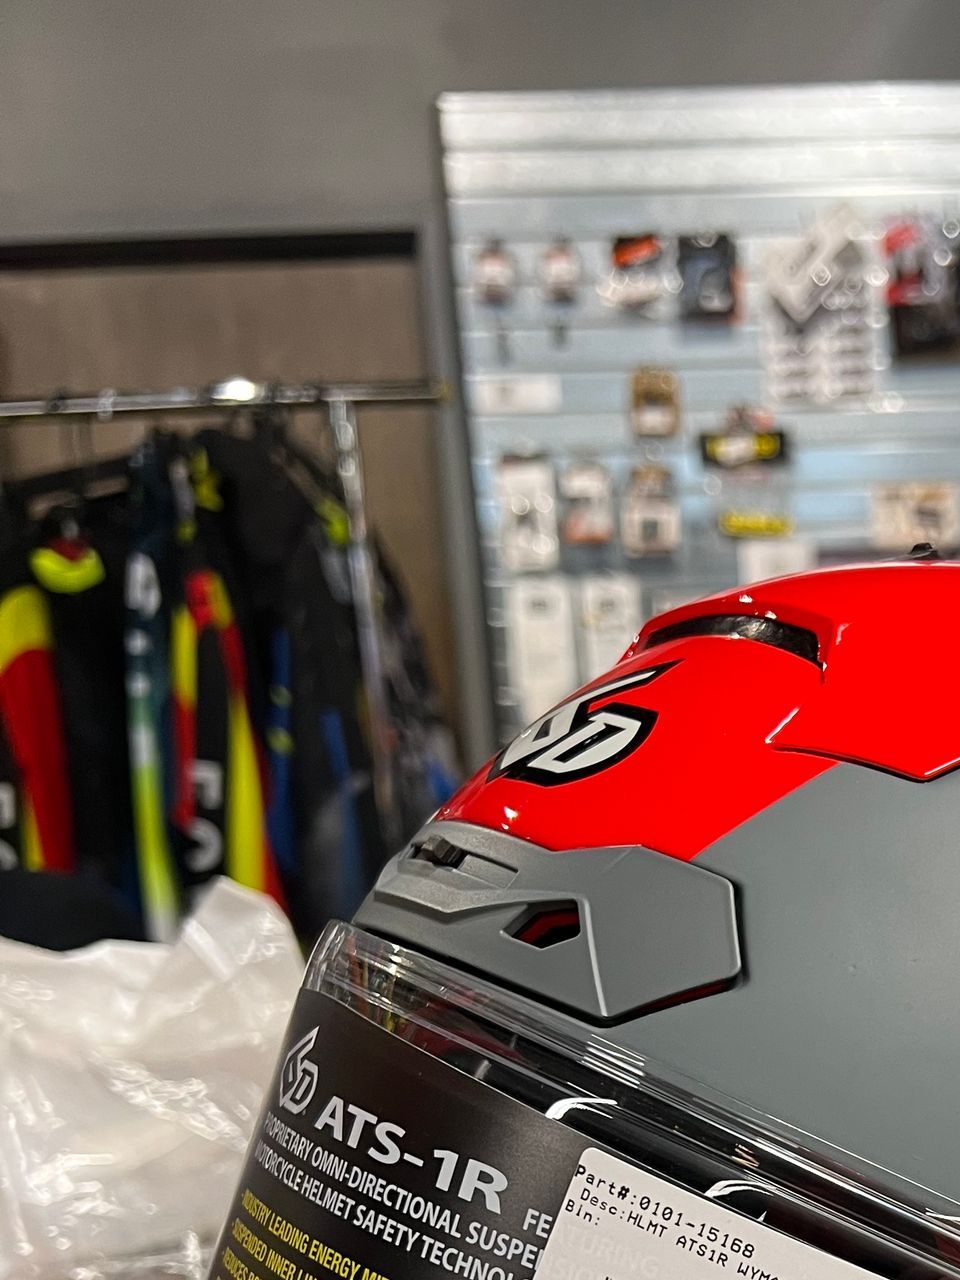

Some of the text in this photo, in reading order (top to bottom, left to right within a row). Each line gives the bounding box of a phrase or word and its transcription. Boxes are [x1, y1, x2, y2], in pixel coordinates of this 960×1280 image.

[254, 1139, 302, 1193] MOTORCYCLE
[301, 1173, 355, 1220] HELMET
[353, 1204, 421, 1251] SAFETY
[264, 1111, 312, 1163] PROPRIETARY
[312, 1148, 461, 1239] OMNI-DIRECTIONAL
[468, 1222, 545, 1271] SUSPE
[315, 1095, 508, 1215] ATS-1R
[232, 1218, 267, 1262] SUSPENDED
[268, 1213, 308, 1254] LEADING
[308, 1233, 360, 1280] ENERGY
[565, 1199, 602, 1227] Bin:
[574, 1164, 756, 1260] Part#:0101-15168
[579, 1187, 667, 1238] Desc:HLMT
[675, 1235, 729, 1268] ATS1R
